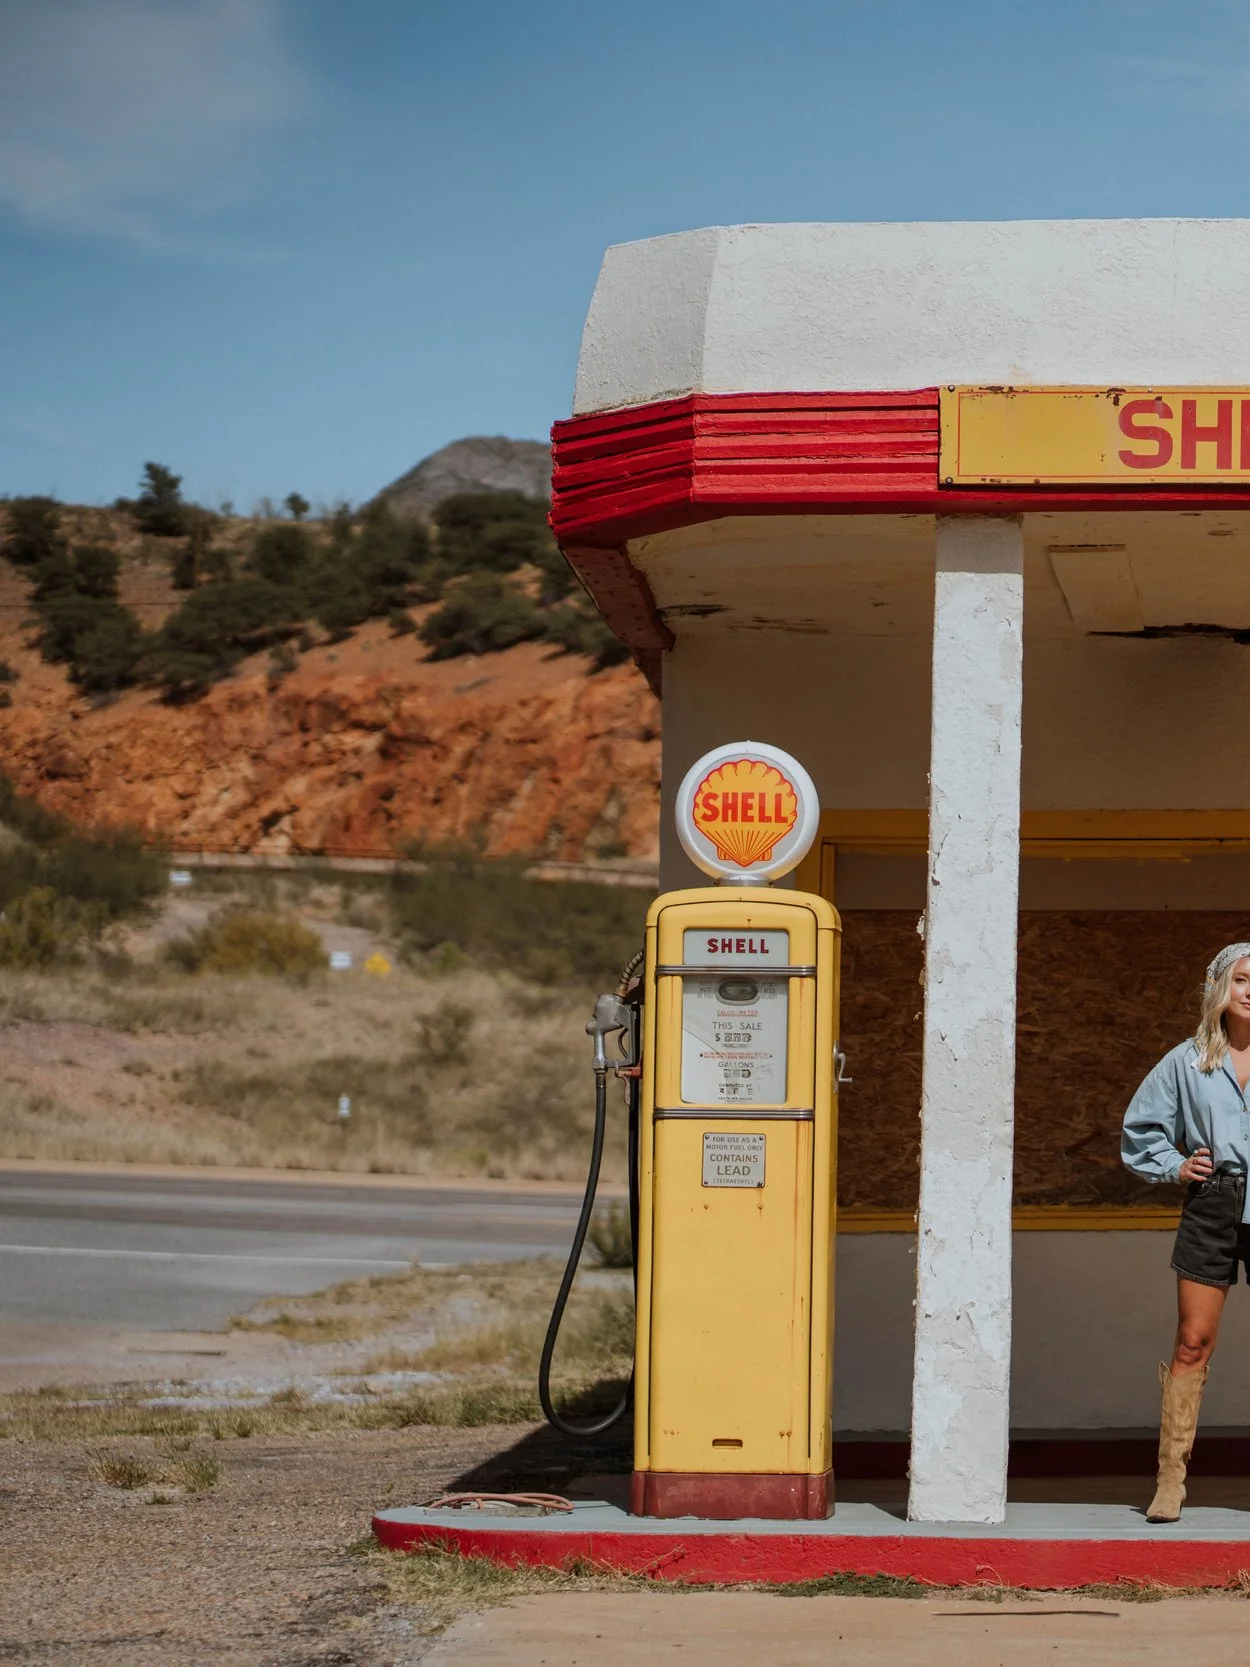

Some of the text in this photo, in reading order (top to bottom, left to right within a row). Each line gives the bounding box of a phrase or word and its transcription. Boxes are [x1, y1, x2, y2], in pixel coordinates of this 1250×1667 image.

[700, 791, 789, 824] SHELL
[707, 938, 770, 954] SHELL
[712, 1021, 763, 1030] THIS SALE
[709, 1153, 759, 1163] CONTAINS
[717, 1165, 751, 1176] LEAD
